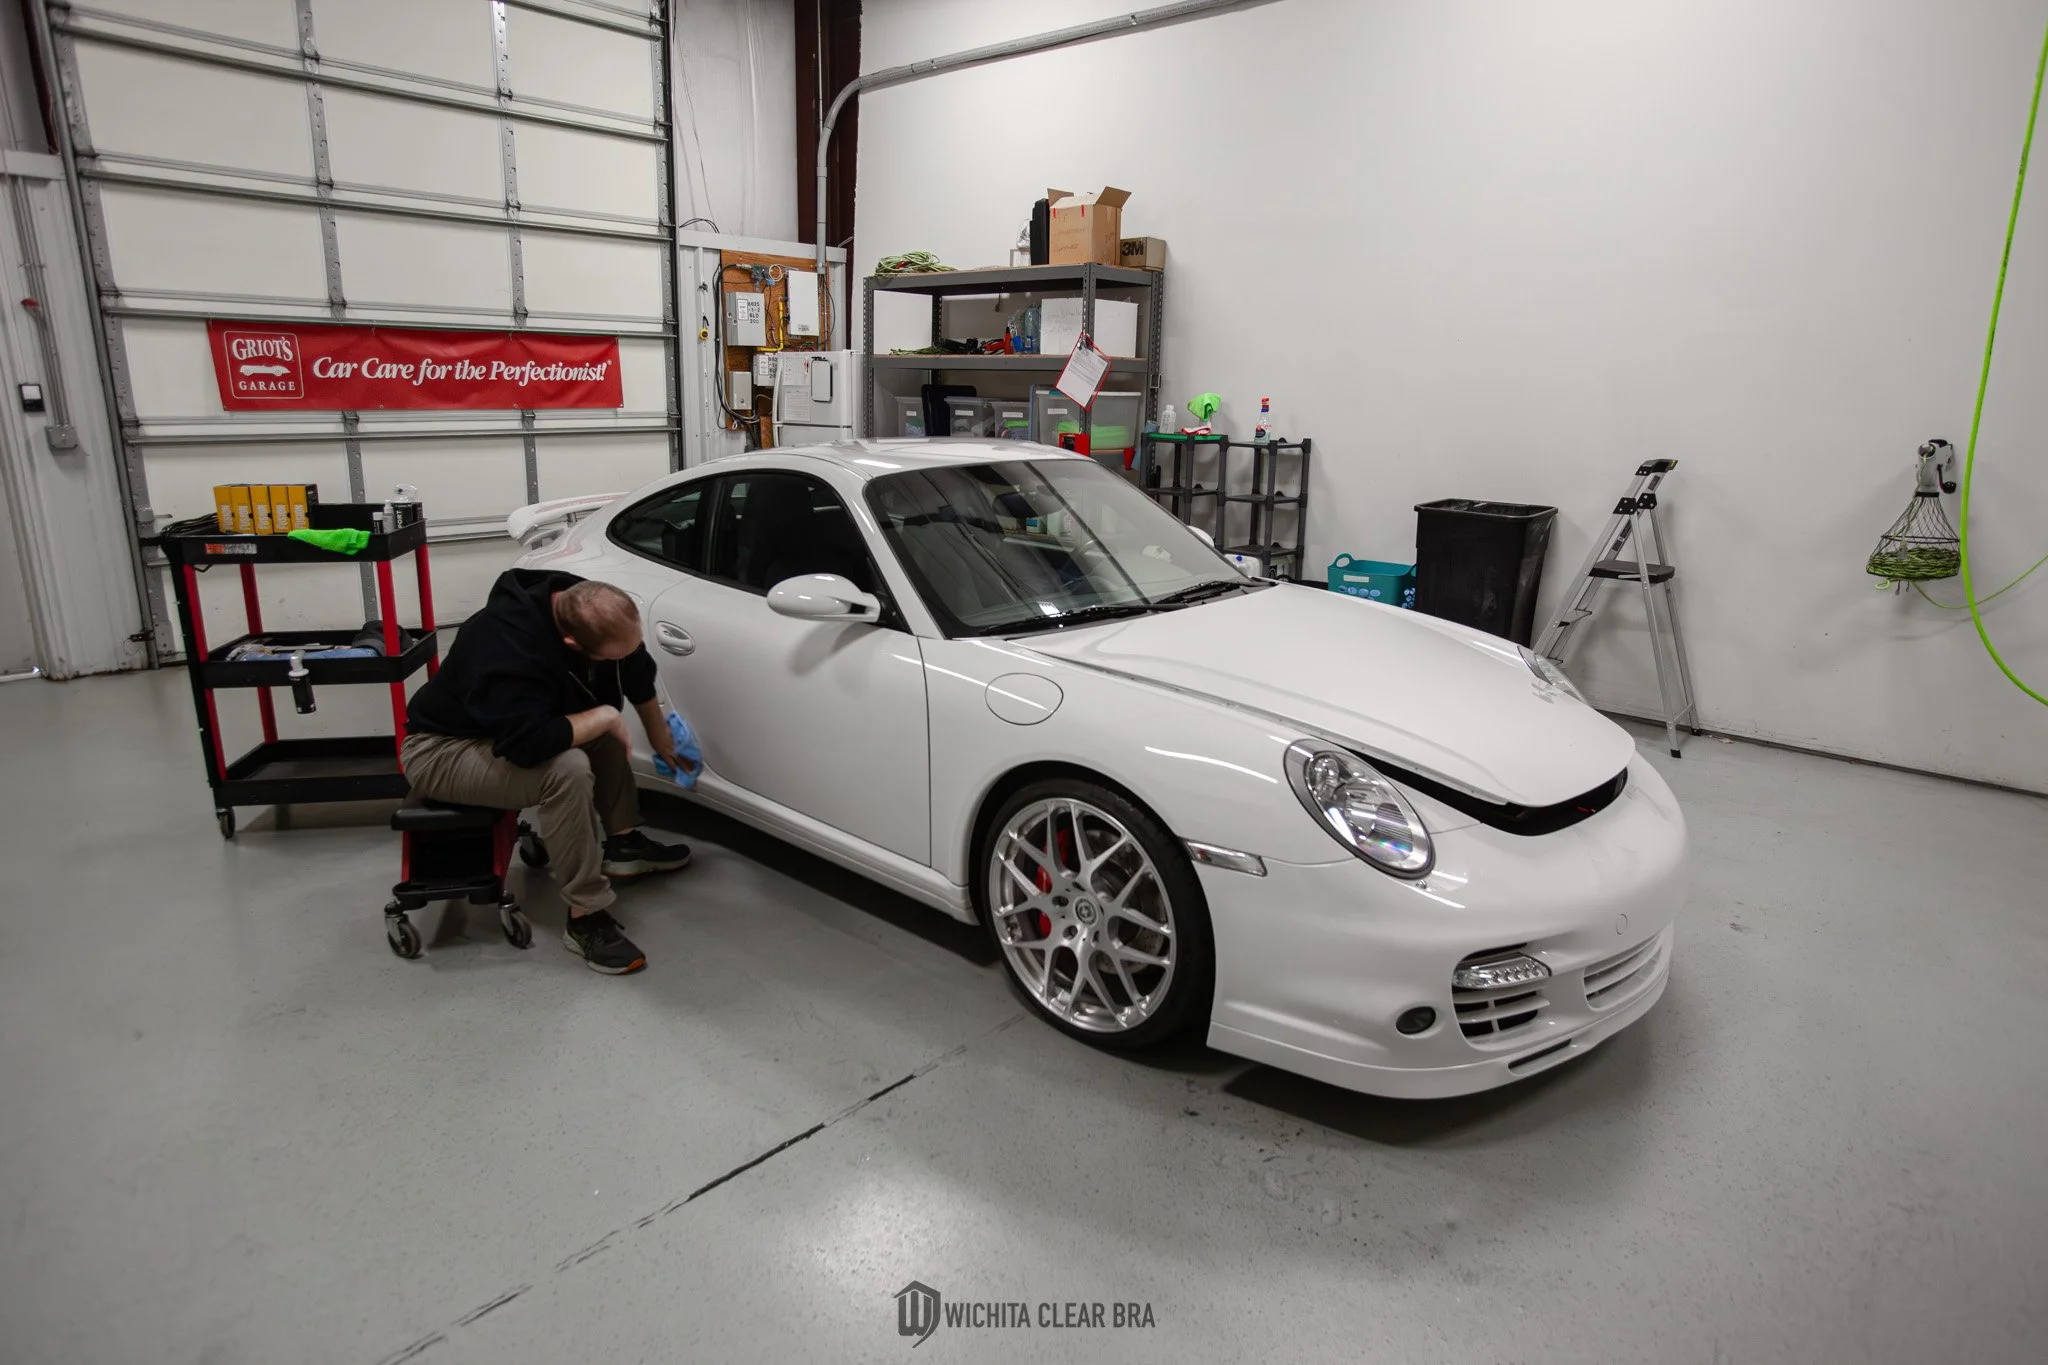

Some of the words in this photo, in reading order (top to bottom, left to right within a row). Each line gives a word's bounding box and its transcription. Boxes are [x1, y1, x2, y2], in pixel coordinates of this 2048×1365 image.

[1121, 240, 1144, 257] 3M
[232, 336, 294, 361] GRIOT'S
[313, 356, 358, 379] Car
[361, 357, 415, 379] Care
[412, 358, 452, 386] for
[454, 359, 487, 380] the
[488, 360, 607, 387] Perfectionist!
[239, 380, 296, 391] GARAGE
[220, 504, 234, 531] FUSION
[237, 504, 251, 531] FUSION
[256, 503, 271, 530] FUSION
